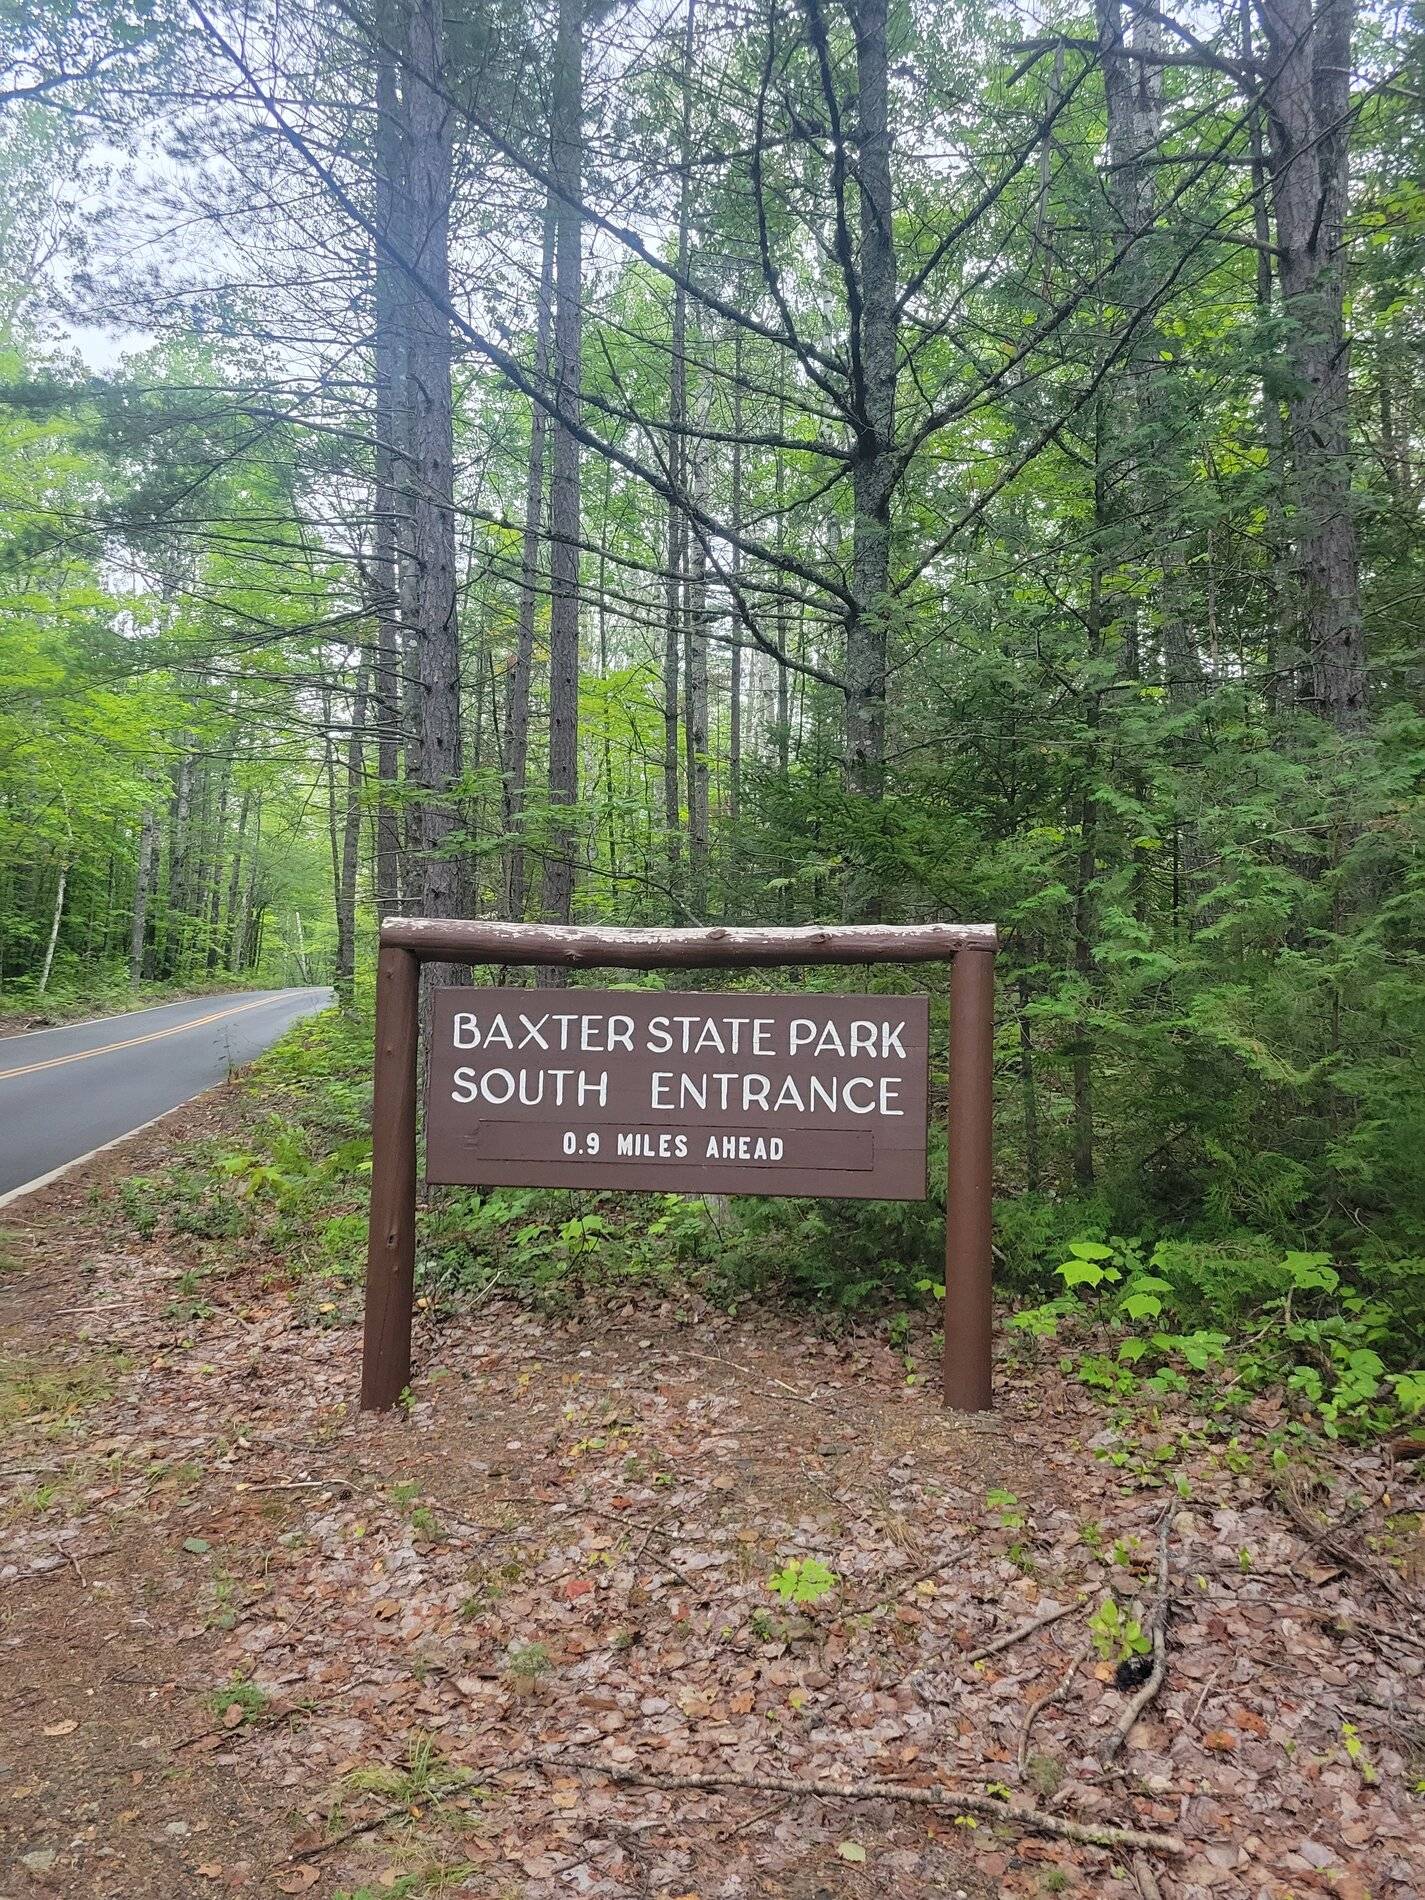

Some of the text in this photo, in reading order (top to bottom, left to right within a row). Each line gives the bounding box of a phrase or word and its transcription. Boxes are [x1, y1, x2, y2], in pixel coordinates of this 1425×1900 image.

[452, 1012, 906, 1058] BAXTER STATE PARK
[451, 1067, 904, 1116] SOUTH ENTRANCE
[562, 1131, 784, 1161] 0.9 MILES AHEAD
